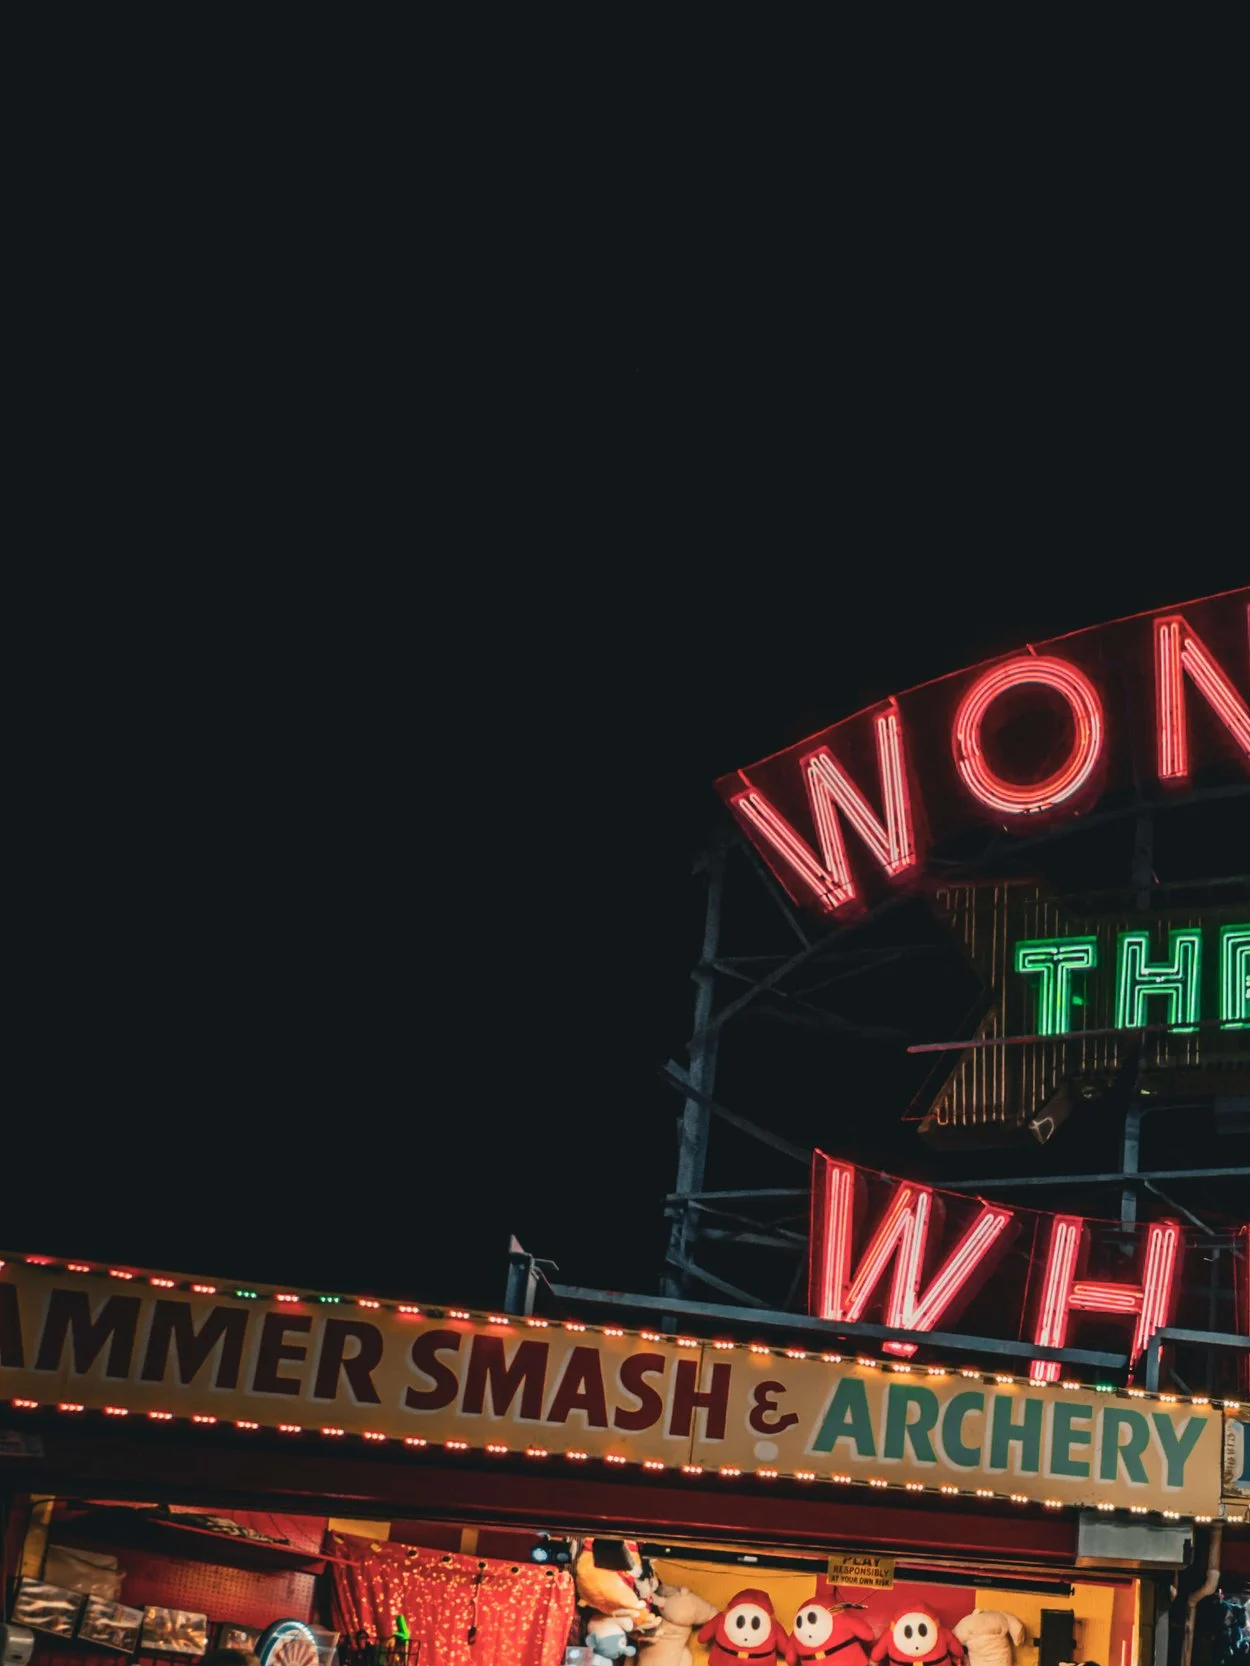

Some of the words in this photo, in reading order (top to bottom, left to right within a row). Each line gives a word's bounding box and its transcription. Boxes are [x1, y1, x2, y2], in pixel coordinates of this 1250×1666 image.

[404, 1329, 732, 1440] SMASH
[749, 1380, 799, 1435] &
[811, 1377, 1209, 1488] ARCHERY
[843, 1556, 880, 1567] PLAY
[833, 1565, 890, 1577] RESPONSIBLY
[841, 1576, 857, 1584] YOUR
[875, 1578, 890, 1586] RISK
